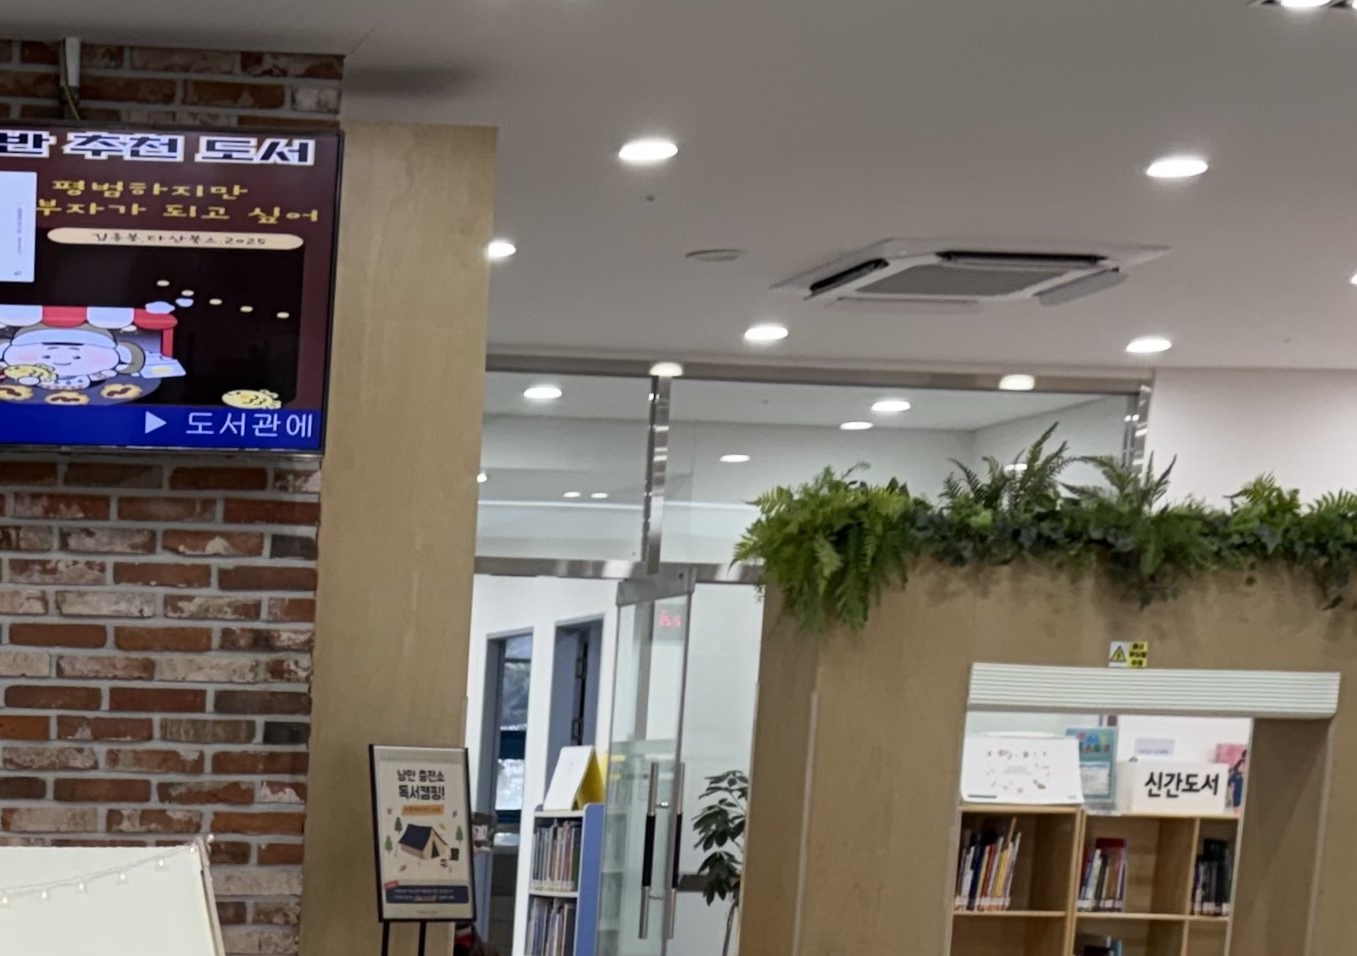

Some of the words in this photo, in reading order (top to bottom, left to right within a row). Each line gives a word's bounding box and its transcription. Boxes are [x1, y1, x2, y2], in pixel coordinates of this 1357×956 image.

[63, 132, 184, 161] 추천
[195, 136, 315, 165] 도서
[53, 180, 247, 200] 평범하지만
[37, 199, 146, 216] 부자가
[163, 204, 229, 219] 되고
[248, 206, 318, 224] 싶어
[186, 412, 312, 438] 도서관에
[1145, 771, 1219, 798] 신간도서
